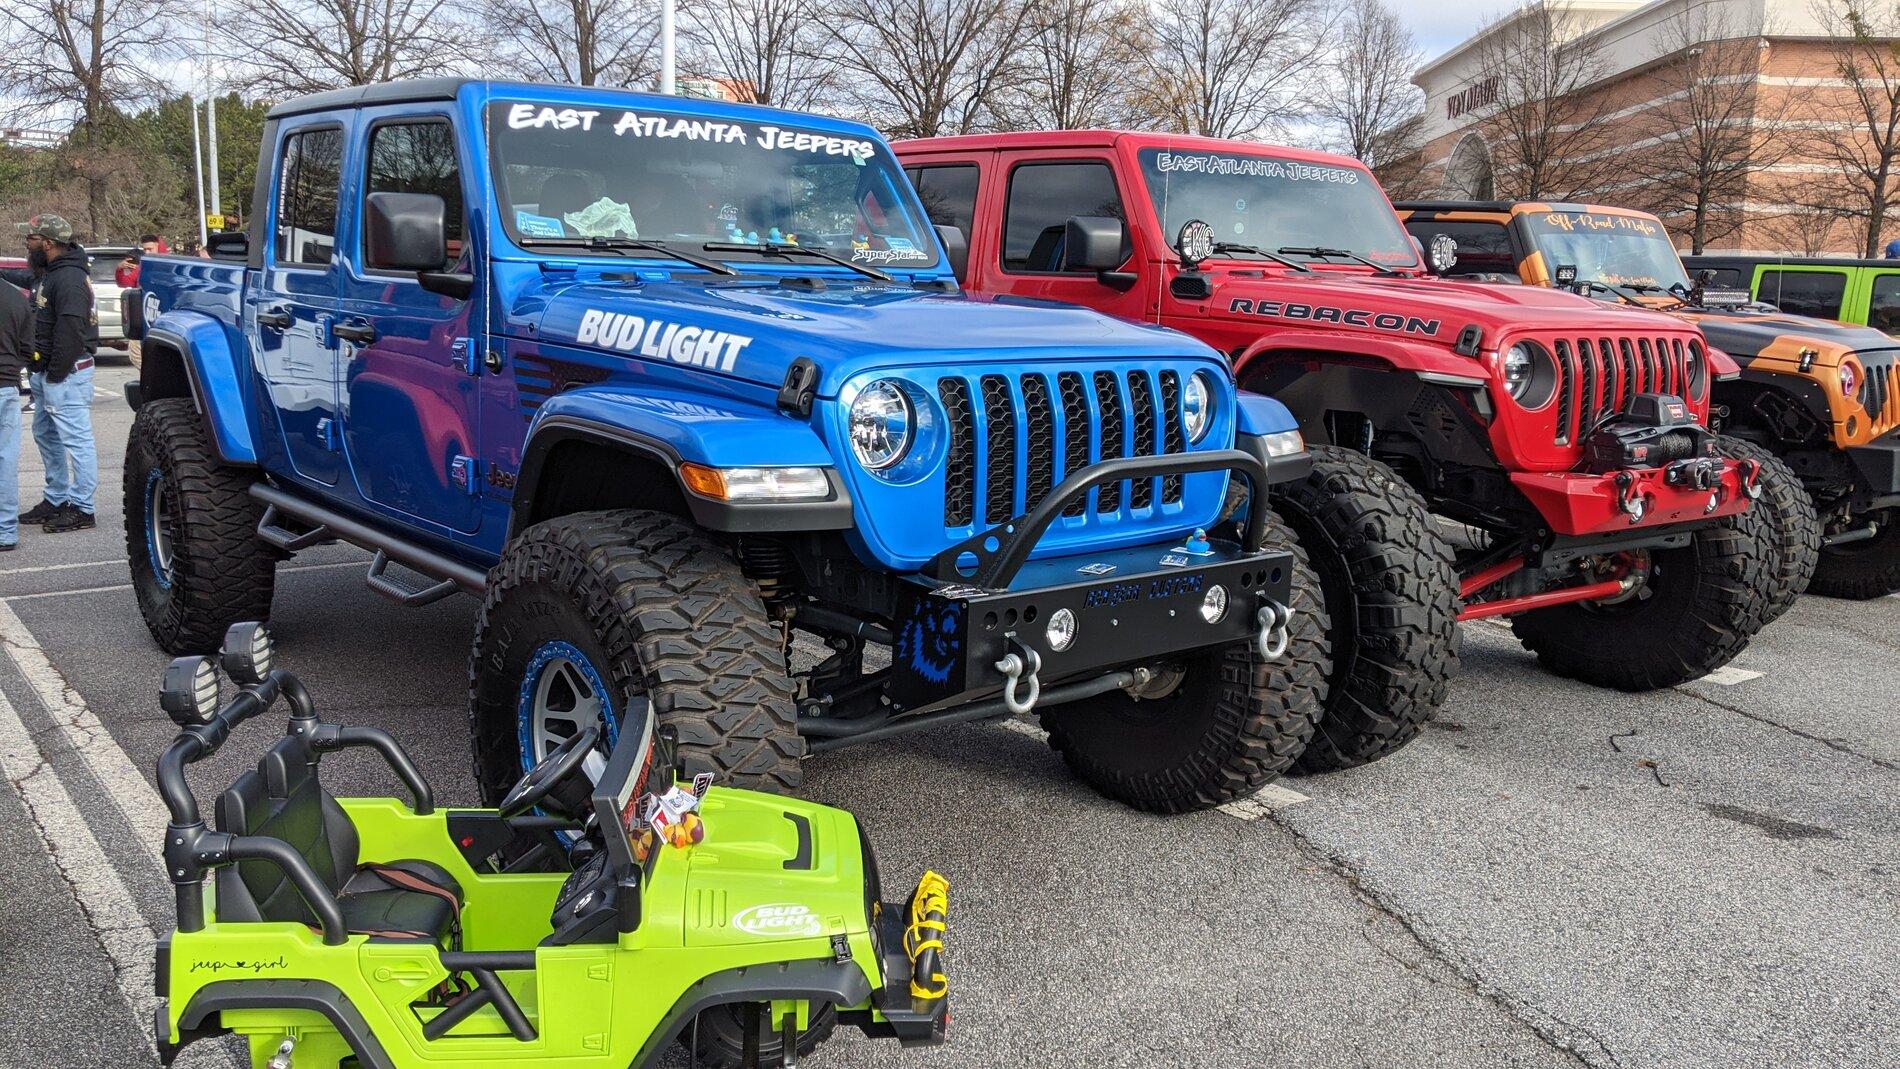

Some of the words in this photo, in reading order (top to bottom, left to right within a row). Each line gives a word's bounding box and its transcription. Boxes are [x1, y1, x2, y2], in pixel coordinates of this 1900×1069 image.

[508, 103, 601, 132] EAST
[613, 111, 748, 146] ATLANTA
[756, 125, 877, 160] JEEPERS
[1156, 151, 1207, 173] EAST
[1206, 154, 1285, 178] ATLANTA
[1286, 162, 1359, 186] JEEPERS
[1227, 297, 1442, 337] REBACON
[576, 308, 646, 353] BUD
[640, 319, 755, 373] LIGHT
[486, 461, 516, 490] Jee
[745, 914, 820, 930] LIGHT
[755, 905, 810, 919] BUD
[253, 955, 288, 973] girl
